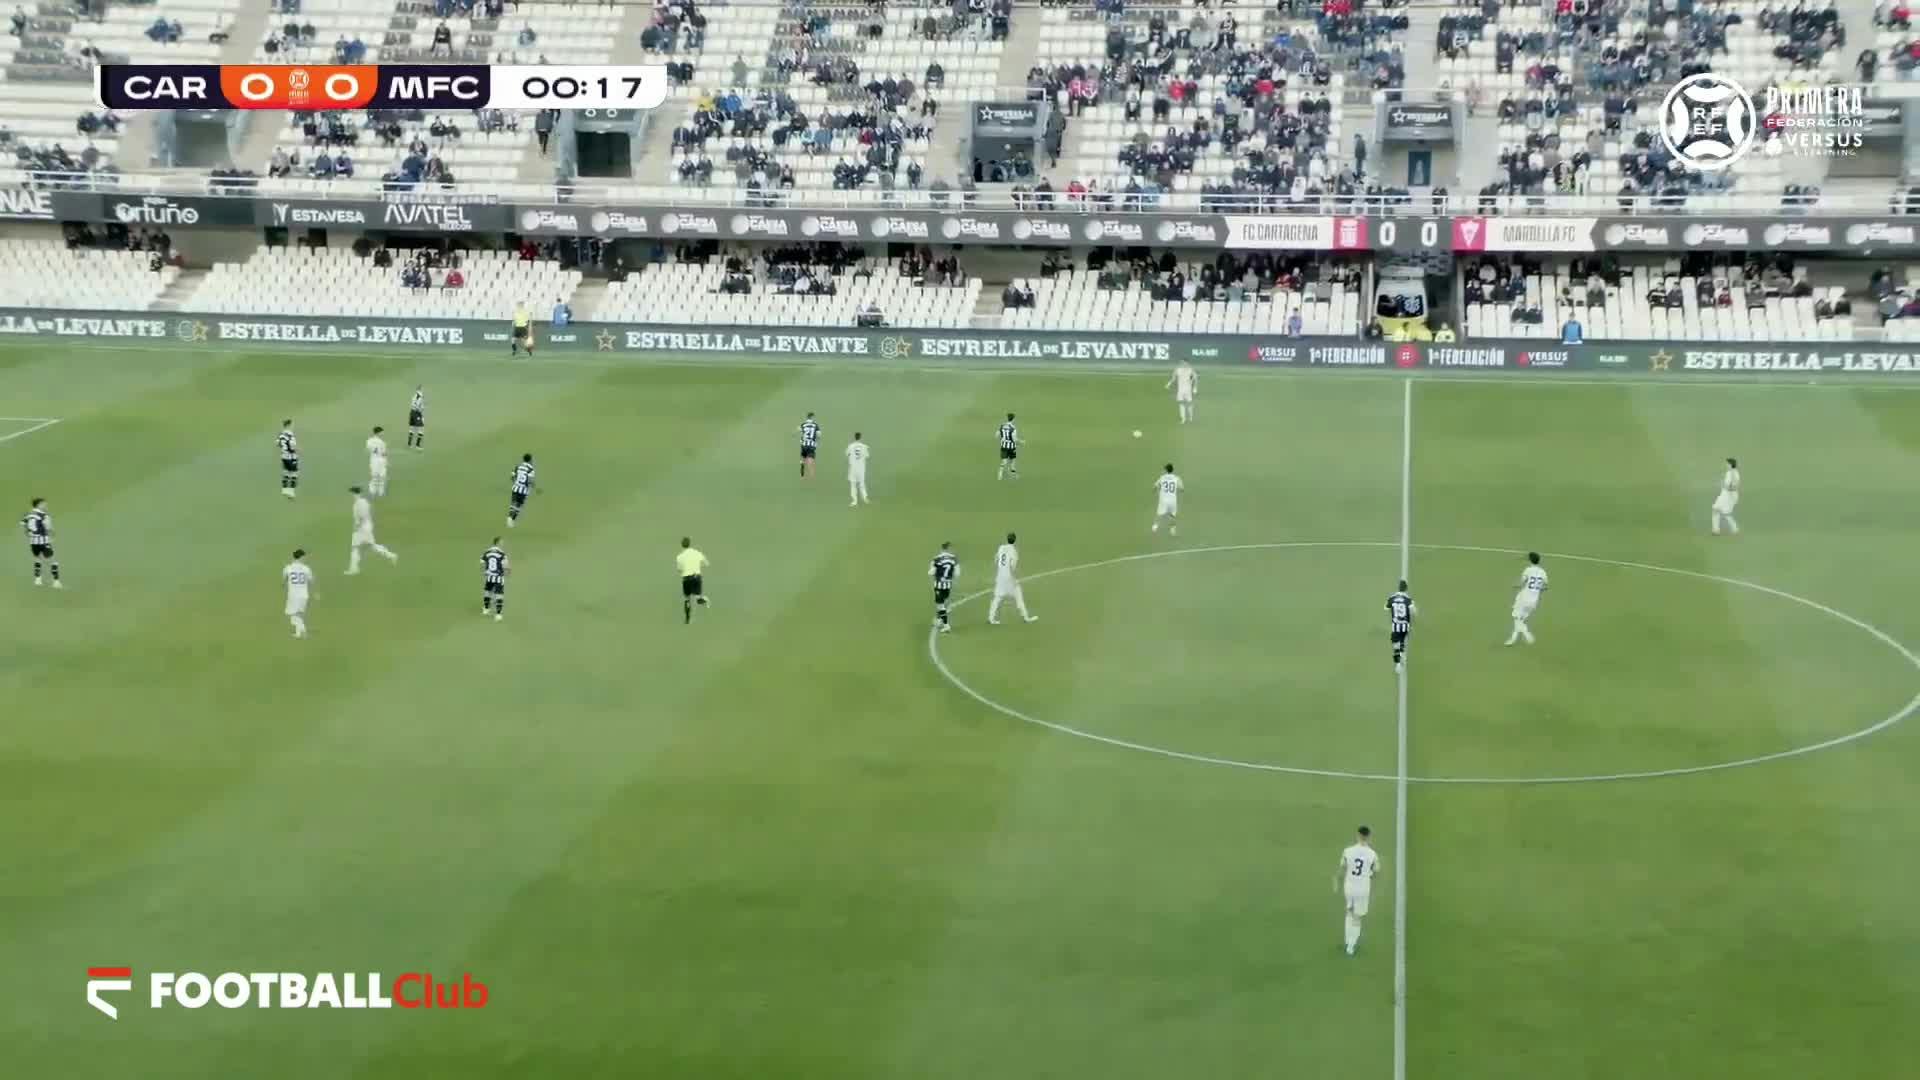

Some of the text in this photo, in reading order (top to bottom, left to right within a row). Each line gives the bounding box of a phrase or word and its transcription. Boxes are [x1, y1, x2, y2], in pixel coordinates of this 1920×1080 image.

[292, 208, 365, 223] ESTAVESA
[384, 204, 472, 224] AVATEL
[1243, 225, 1318, 241] FC CARTAGENA
[1380, 221, 1437, 246] 0 0
[54, 317, 165, 337] LEVANTE
[219, 322, 340, 342] ESTRELLA
[357, 325, 463, 344] LEVANTE
[626, 331, 744, 350] ESTRELLA
[762, 335, 868, 353] LEVANTE
[921, 338, 1041, 357] ESTRELLA
[1060, 342, 1169, 360] LEVANTE
[1257, 347, 1296, 357] VERSUS
[1322, 345, 1385, 364] FEDERACIÓN
[1441, 347, 1504, 366] FEDERACIÓN
[1528, 352, 1568, 362] VERSUS
[1684, 352, 1821, 370] ESTRELLA
[1163, 481, 1176, 493] 30
[943, 565, 952, 578] 7
[1352, 858, 1364, 876] 3
